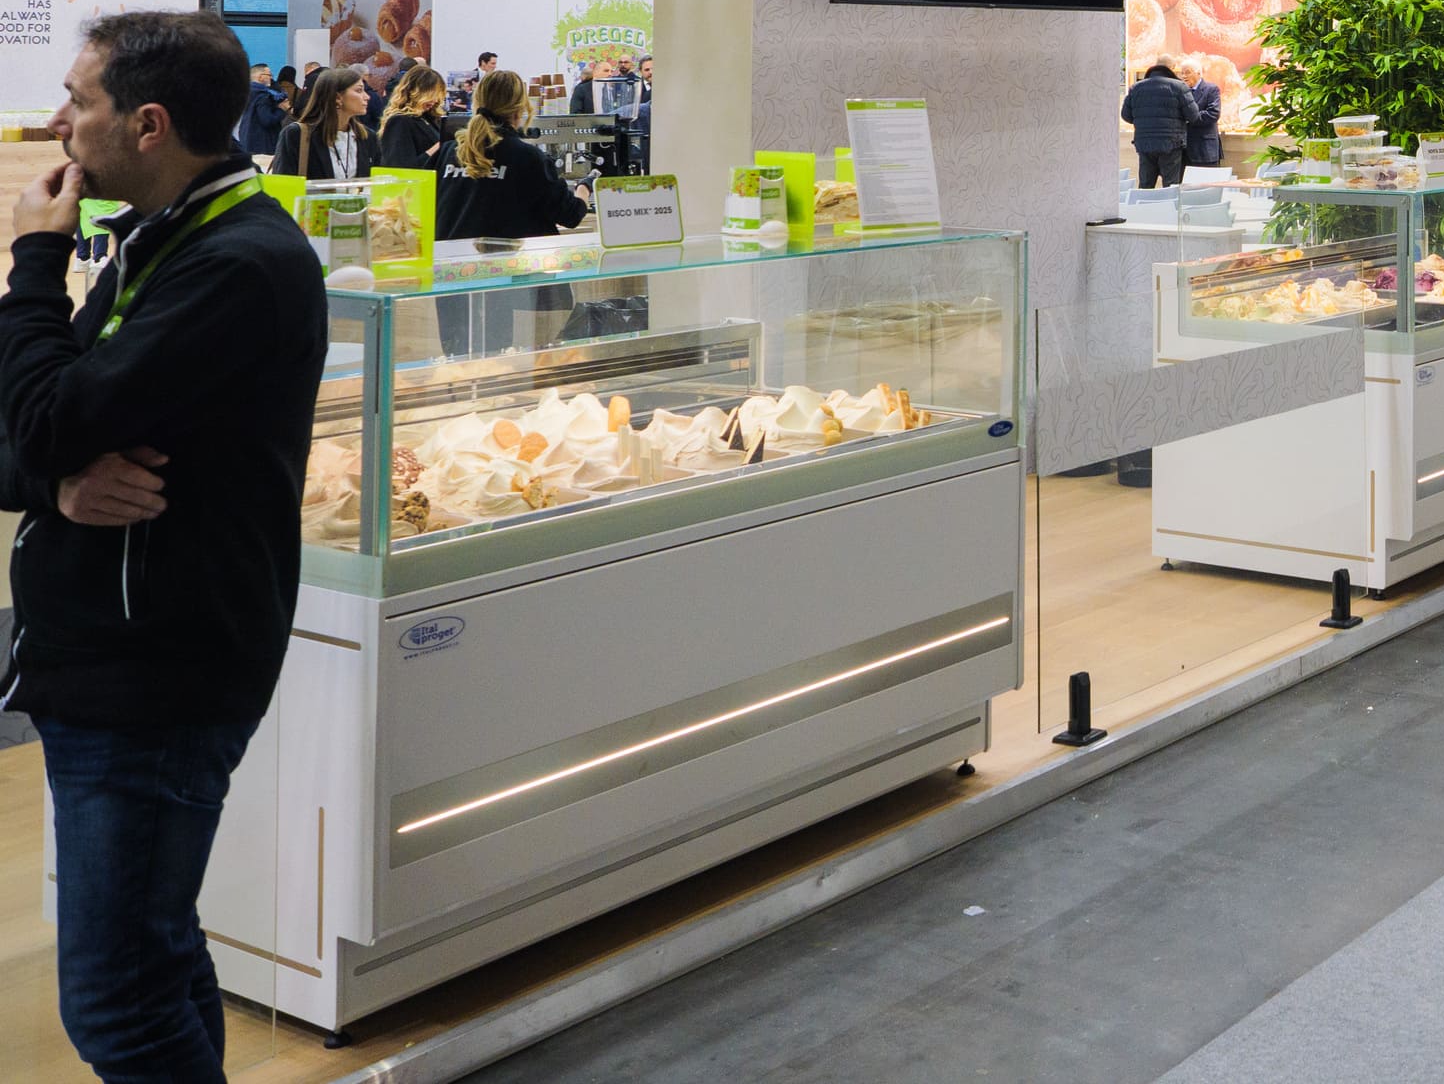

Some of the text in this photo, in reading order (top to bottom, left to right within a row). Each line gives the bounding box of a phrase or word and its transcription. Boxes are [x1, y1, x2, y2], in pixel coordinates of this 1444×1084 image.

[28, 0, 52, 9] HAS
[0, 11, 52, 21] ALWAYS
[0, 23, 51, 33] OOD FOR
[0, 35, 51, 45] VATION
[569, 27, 645, 48] PREGEL
[444, 164, 508, 180] Preel
[607, 209, 632, 218] BISCO
[654, 206, 673, 215] 2025
